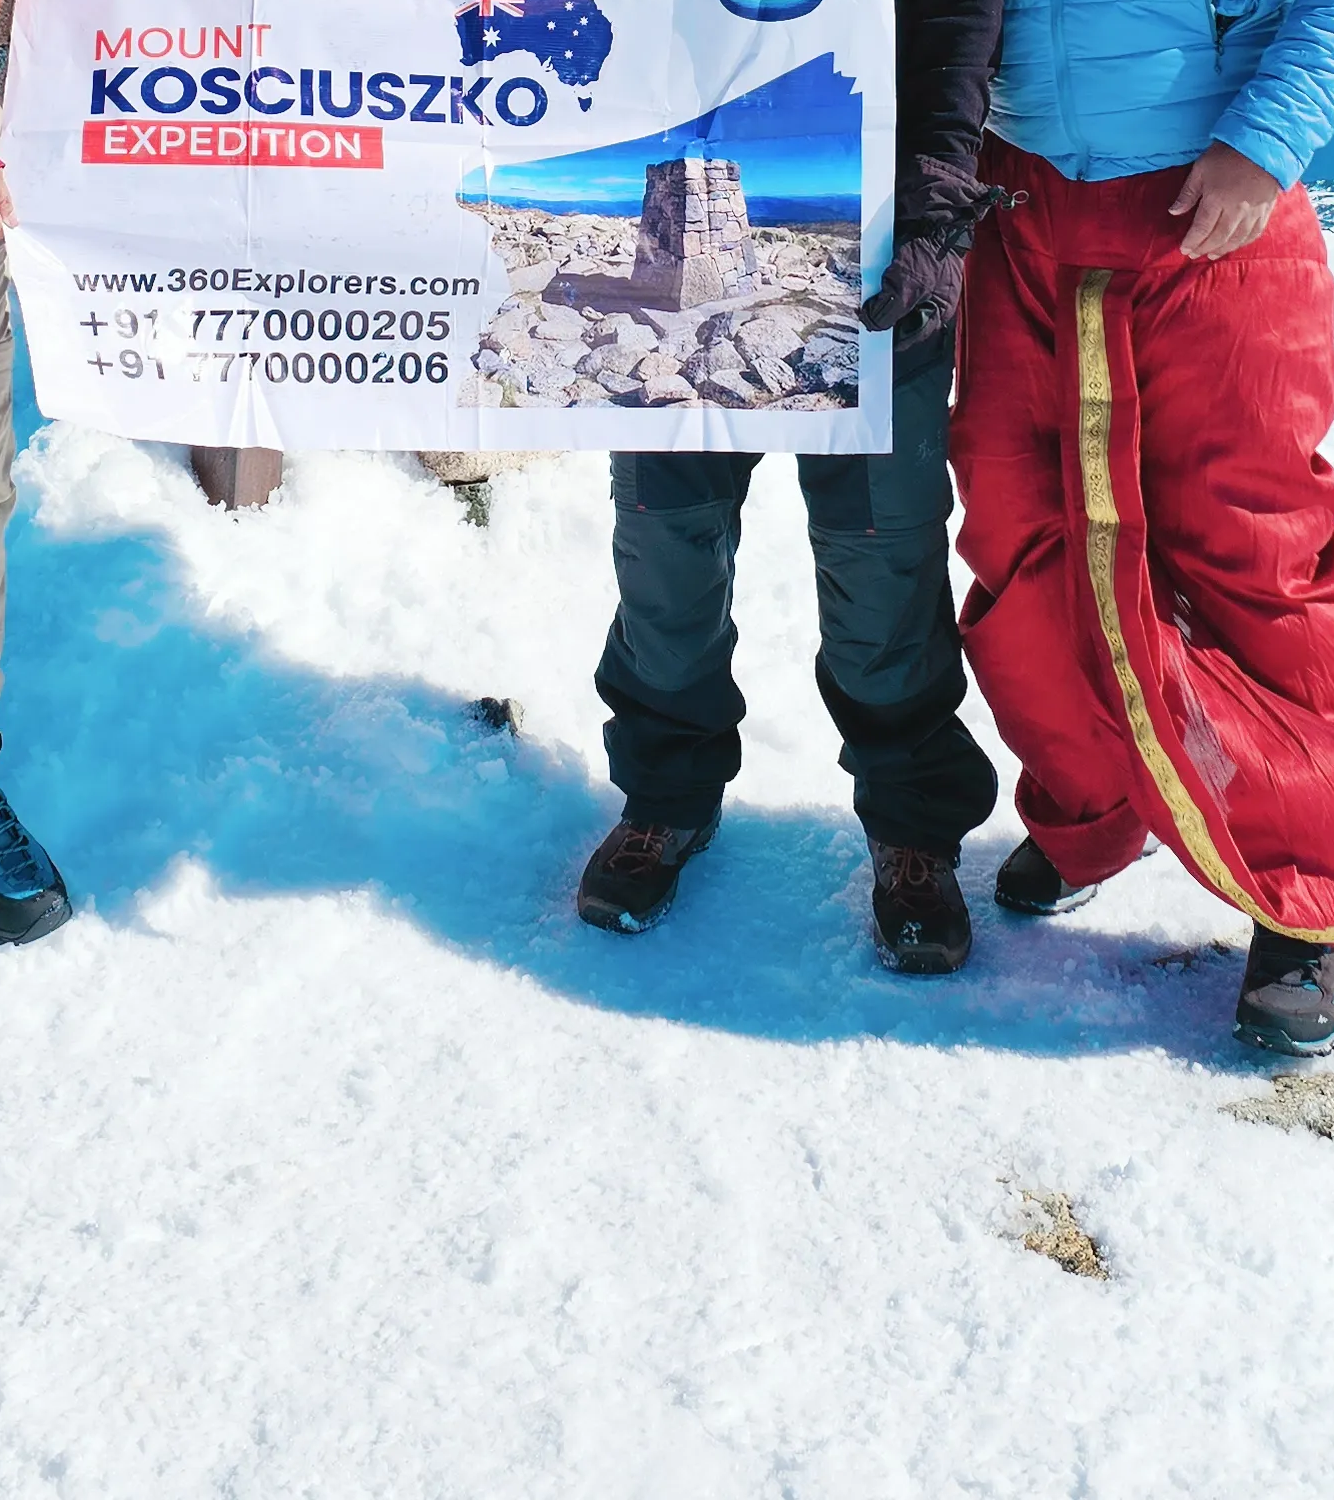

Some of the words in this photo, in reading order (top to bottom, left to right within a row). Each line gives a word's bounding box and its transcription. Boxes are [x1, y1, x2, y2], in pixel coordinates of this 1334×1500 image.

[95, 23, 272, 61] MOUNT
[90, 66, 548, 127] KOSCIUSZKO
[103, 123, 363, 160] EXPEDITION
[74, 268, 480, 298] www.360Explorers.com
[190, 309, 450, 341] 7770000205
[86, 349, 166, 380] +91
[186, 351, 449, 384] 7770000206
